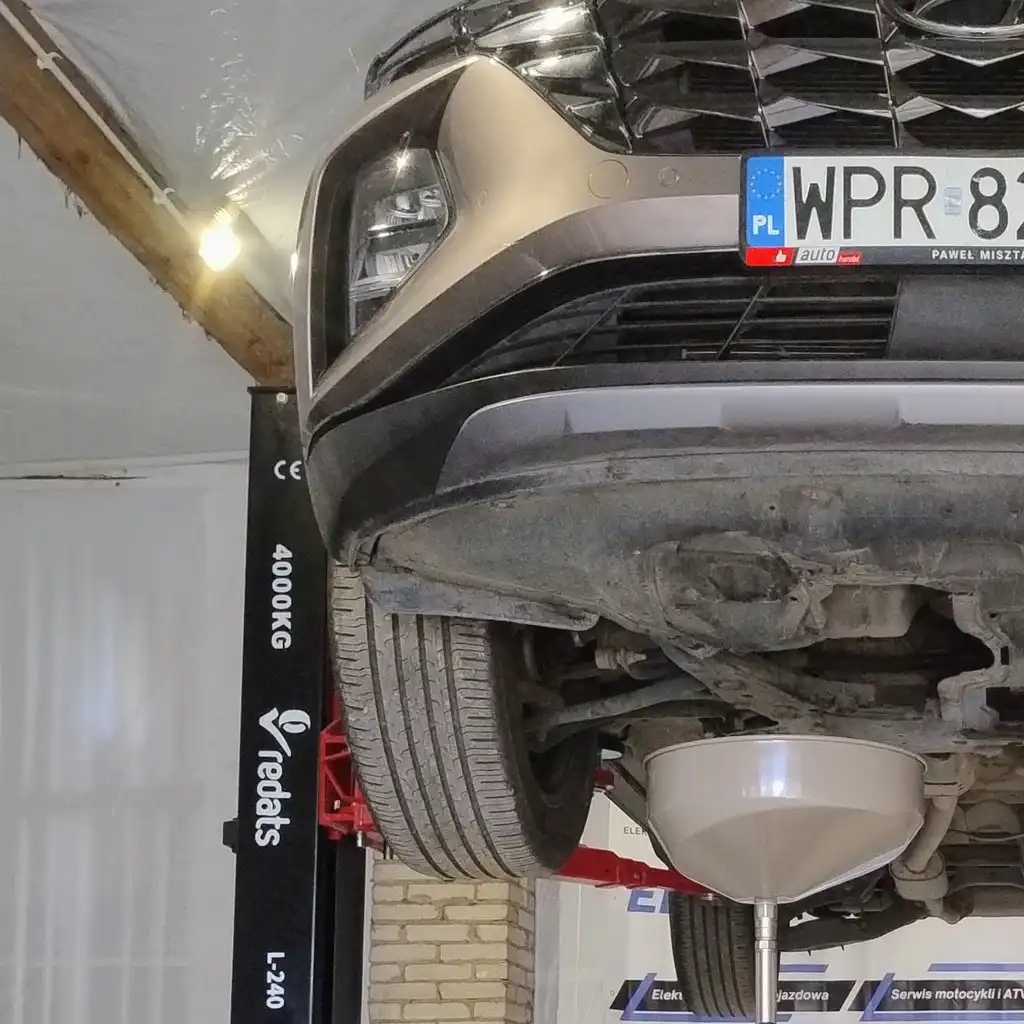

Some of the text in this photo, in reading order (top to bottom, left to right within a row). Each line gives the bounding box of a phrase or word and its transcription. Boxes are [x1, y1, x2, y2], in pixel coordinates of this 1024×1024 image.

[792, 165, 937, 240] WPR
[752, 214, 779, 236] PL
[800, 247, 836, 262] auto
[931, 249, 975, 260] PAWEŁ
[271, 543, 293, 651] 4000KG
[255, 749, 292, 848] redats
[265, 951, 286, 1010] L-240
[890, 988, 932, 1000] Serwis
[934, 988, 995, 1002] motocykli
[997, 988, 1002, 999] i
